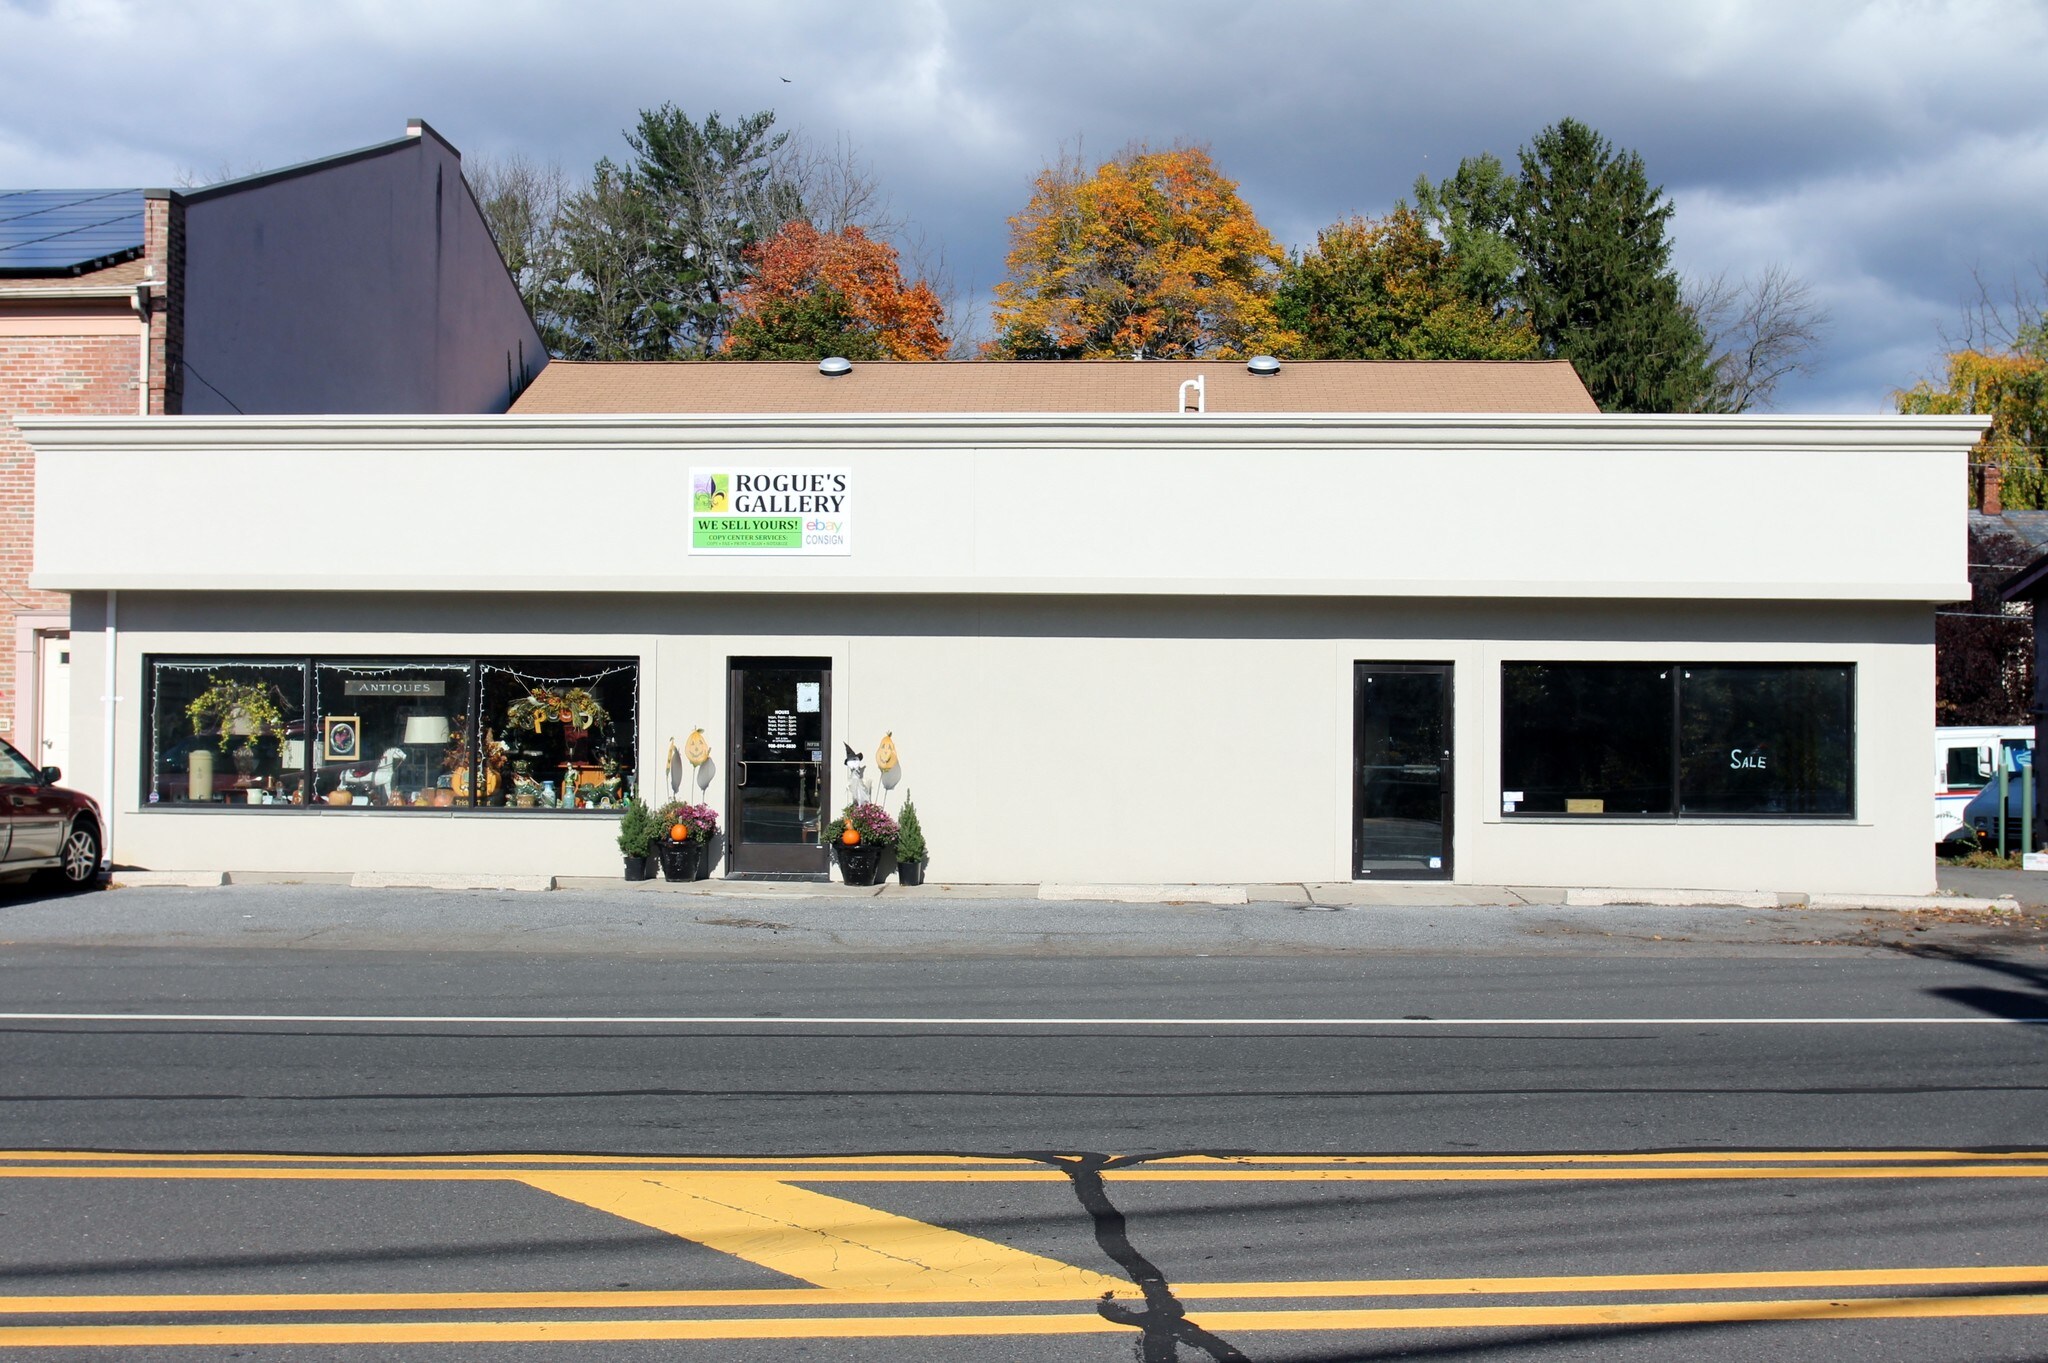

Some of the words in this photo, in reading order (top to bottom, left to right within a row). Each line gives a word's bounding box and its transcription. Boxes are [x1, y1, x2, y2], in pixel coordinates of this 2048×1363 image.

[736, 474, 846, 492] ROGUE'S
[735, 495, 845, 513] GALLERY
[698, 520, 718, 530] WE
[721, 520, 751, 530] SELL
[753, 520, 798, 530] YOURS!
[806, 519, 843, 533] ebay
[806, 535, 844, 545] CONSIGN
[359, 683, 431, 693] ANTIQUES
